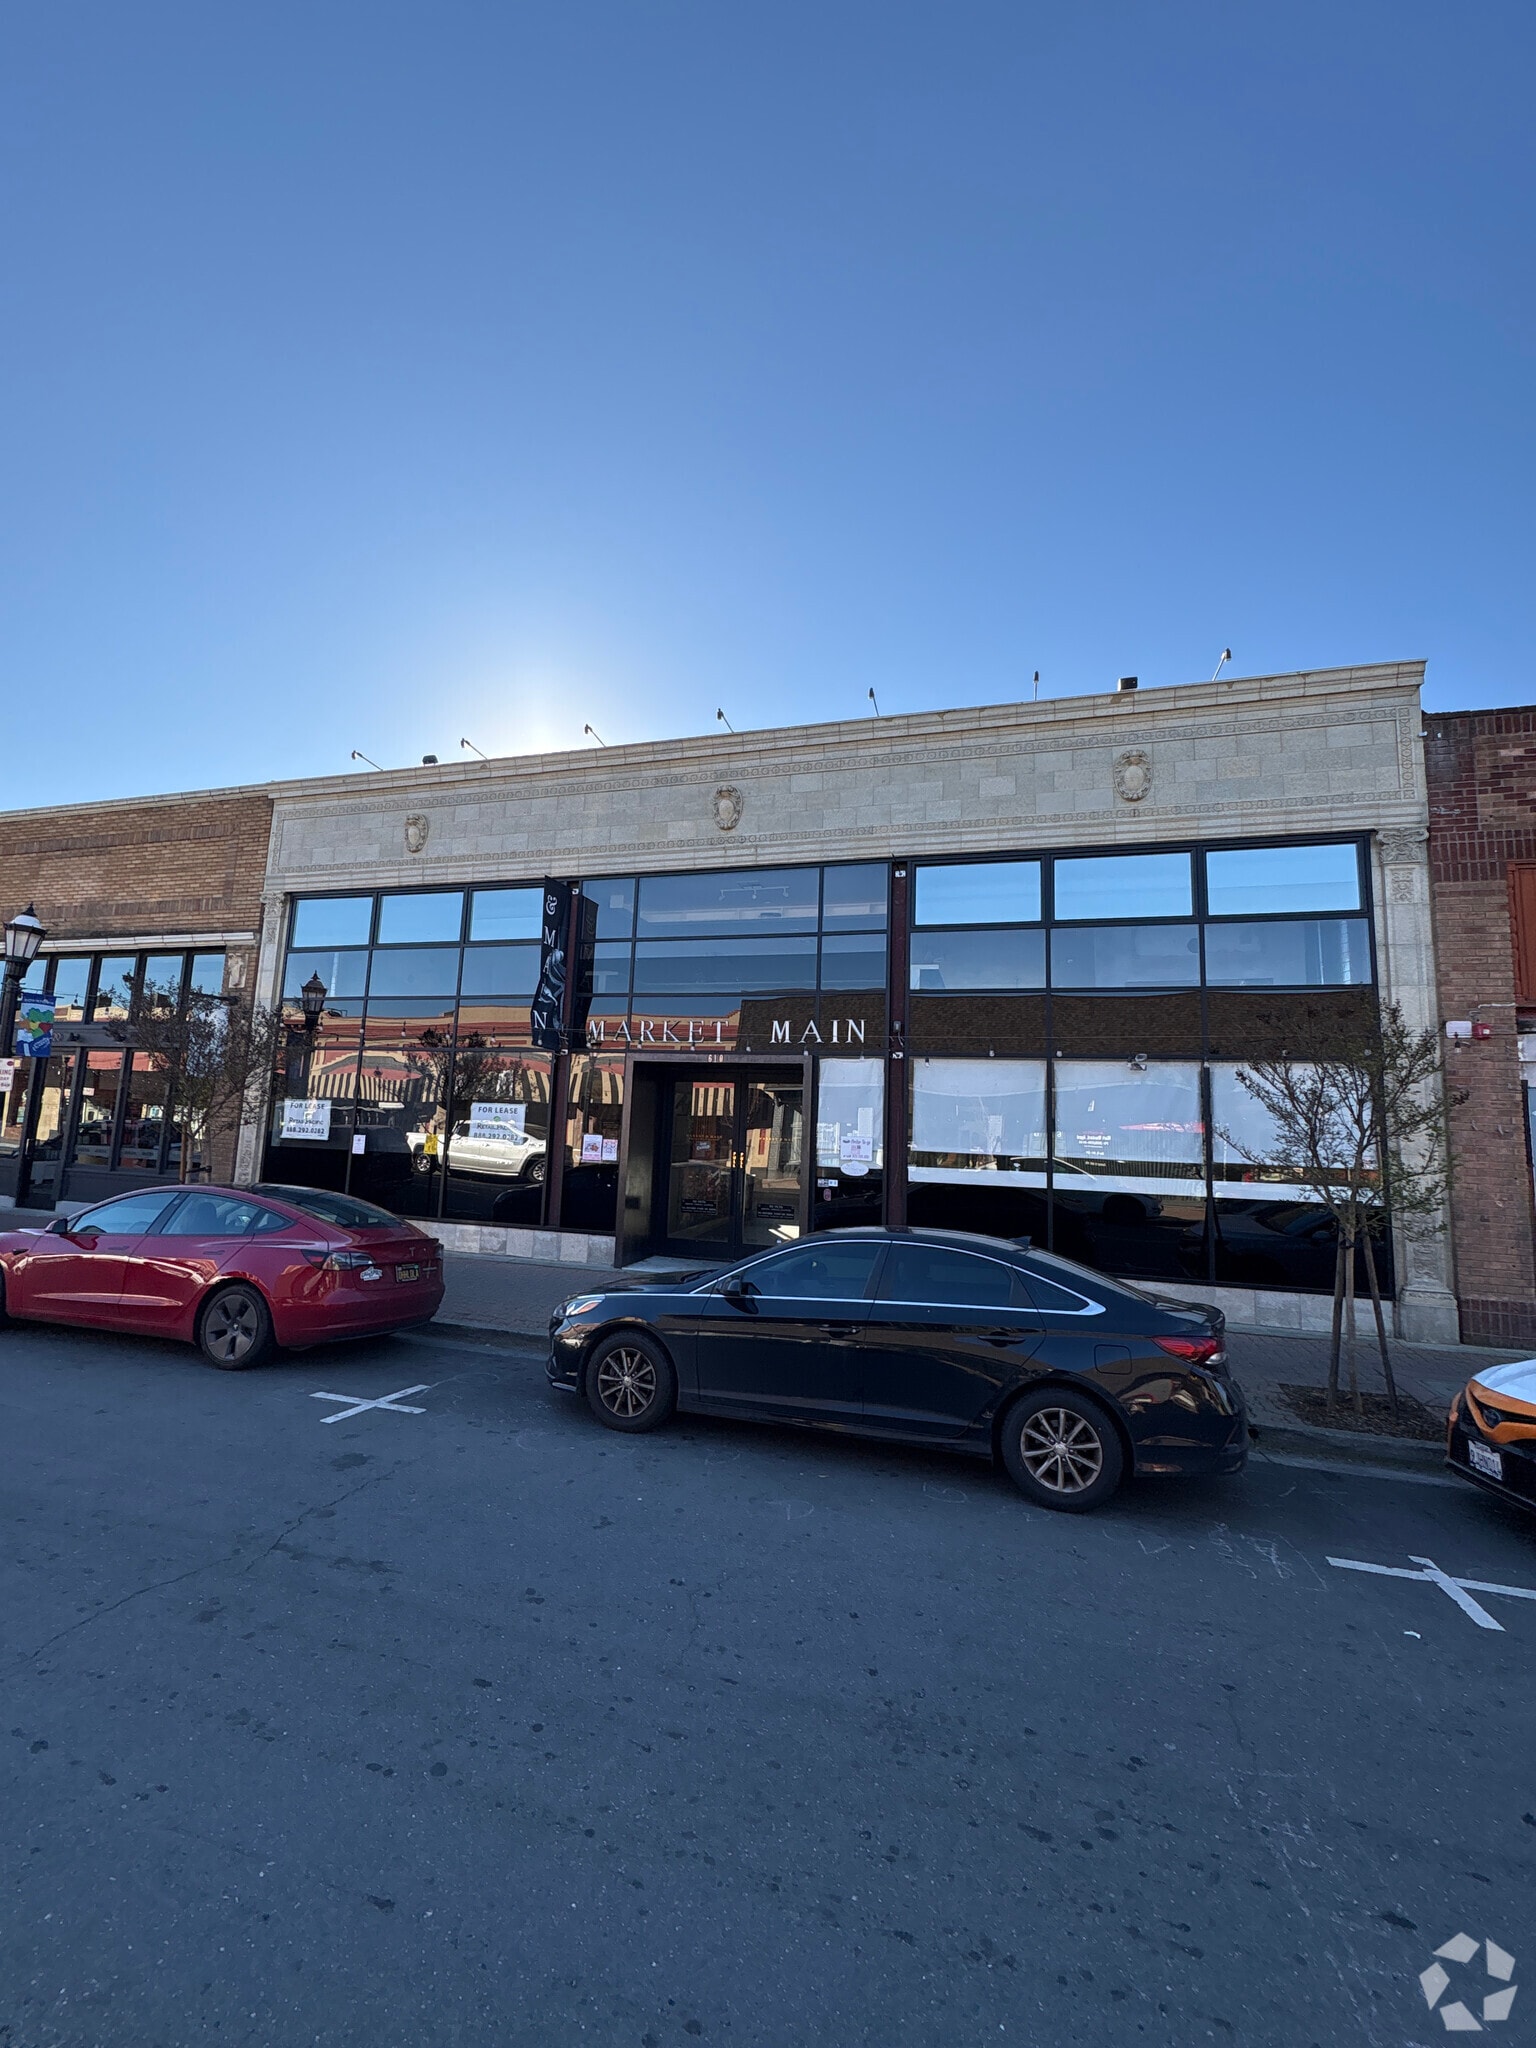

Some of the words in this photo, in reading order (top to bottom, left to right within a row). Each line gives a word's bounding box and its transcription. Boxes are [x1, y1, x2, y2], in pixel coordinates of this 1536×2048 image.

[545, 894, 558, 916] &
[588, 1019, 729, 1044] MARKET
[769, 1018, 867, 1044] MAIN
[707, 1054, 724, 1063] 610
